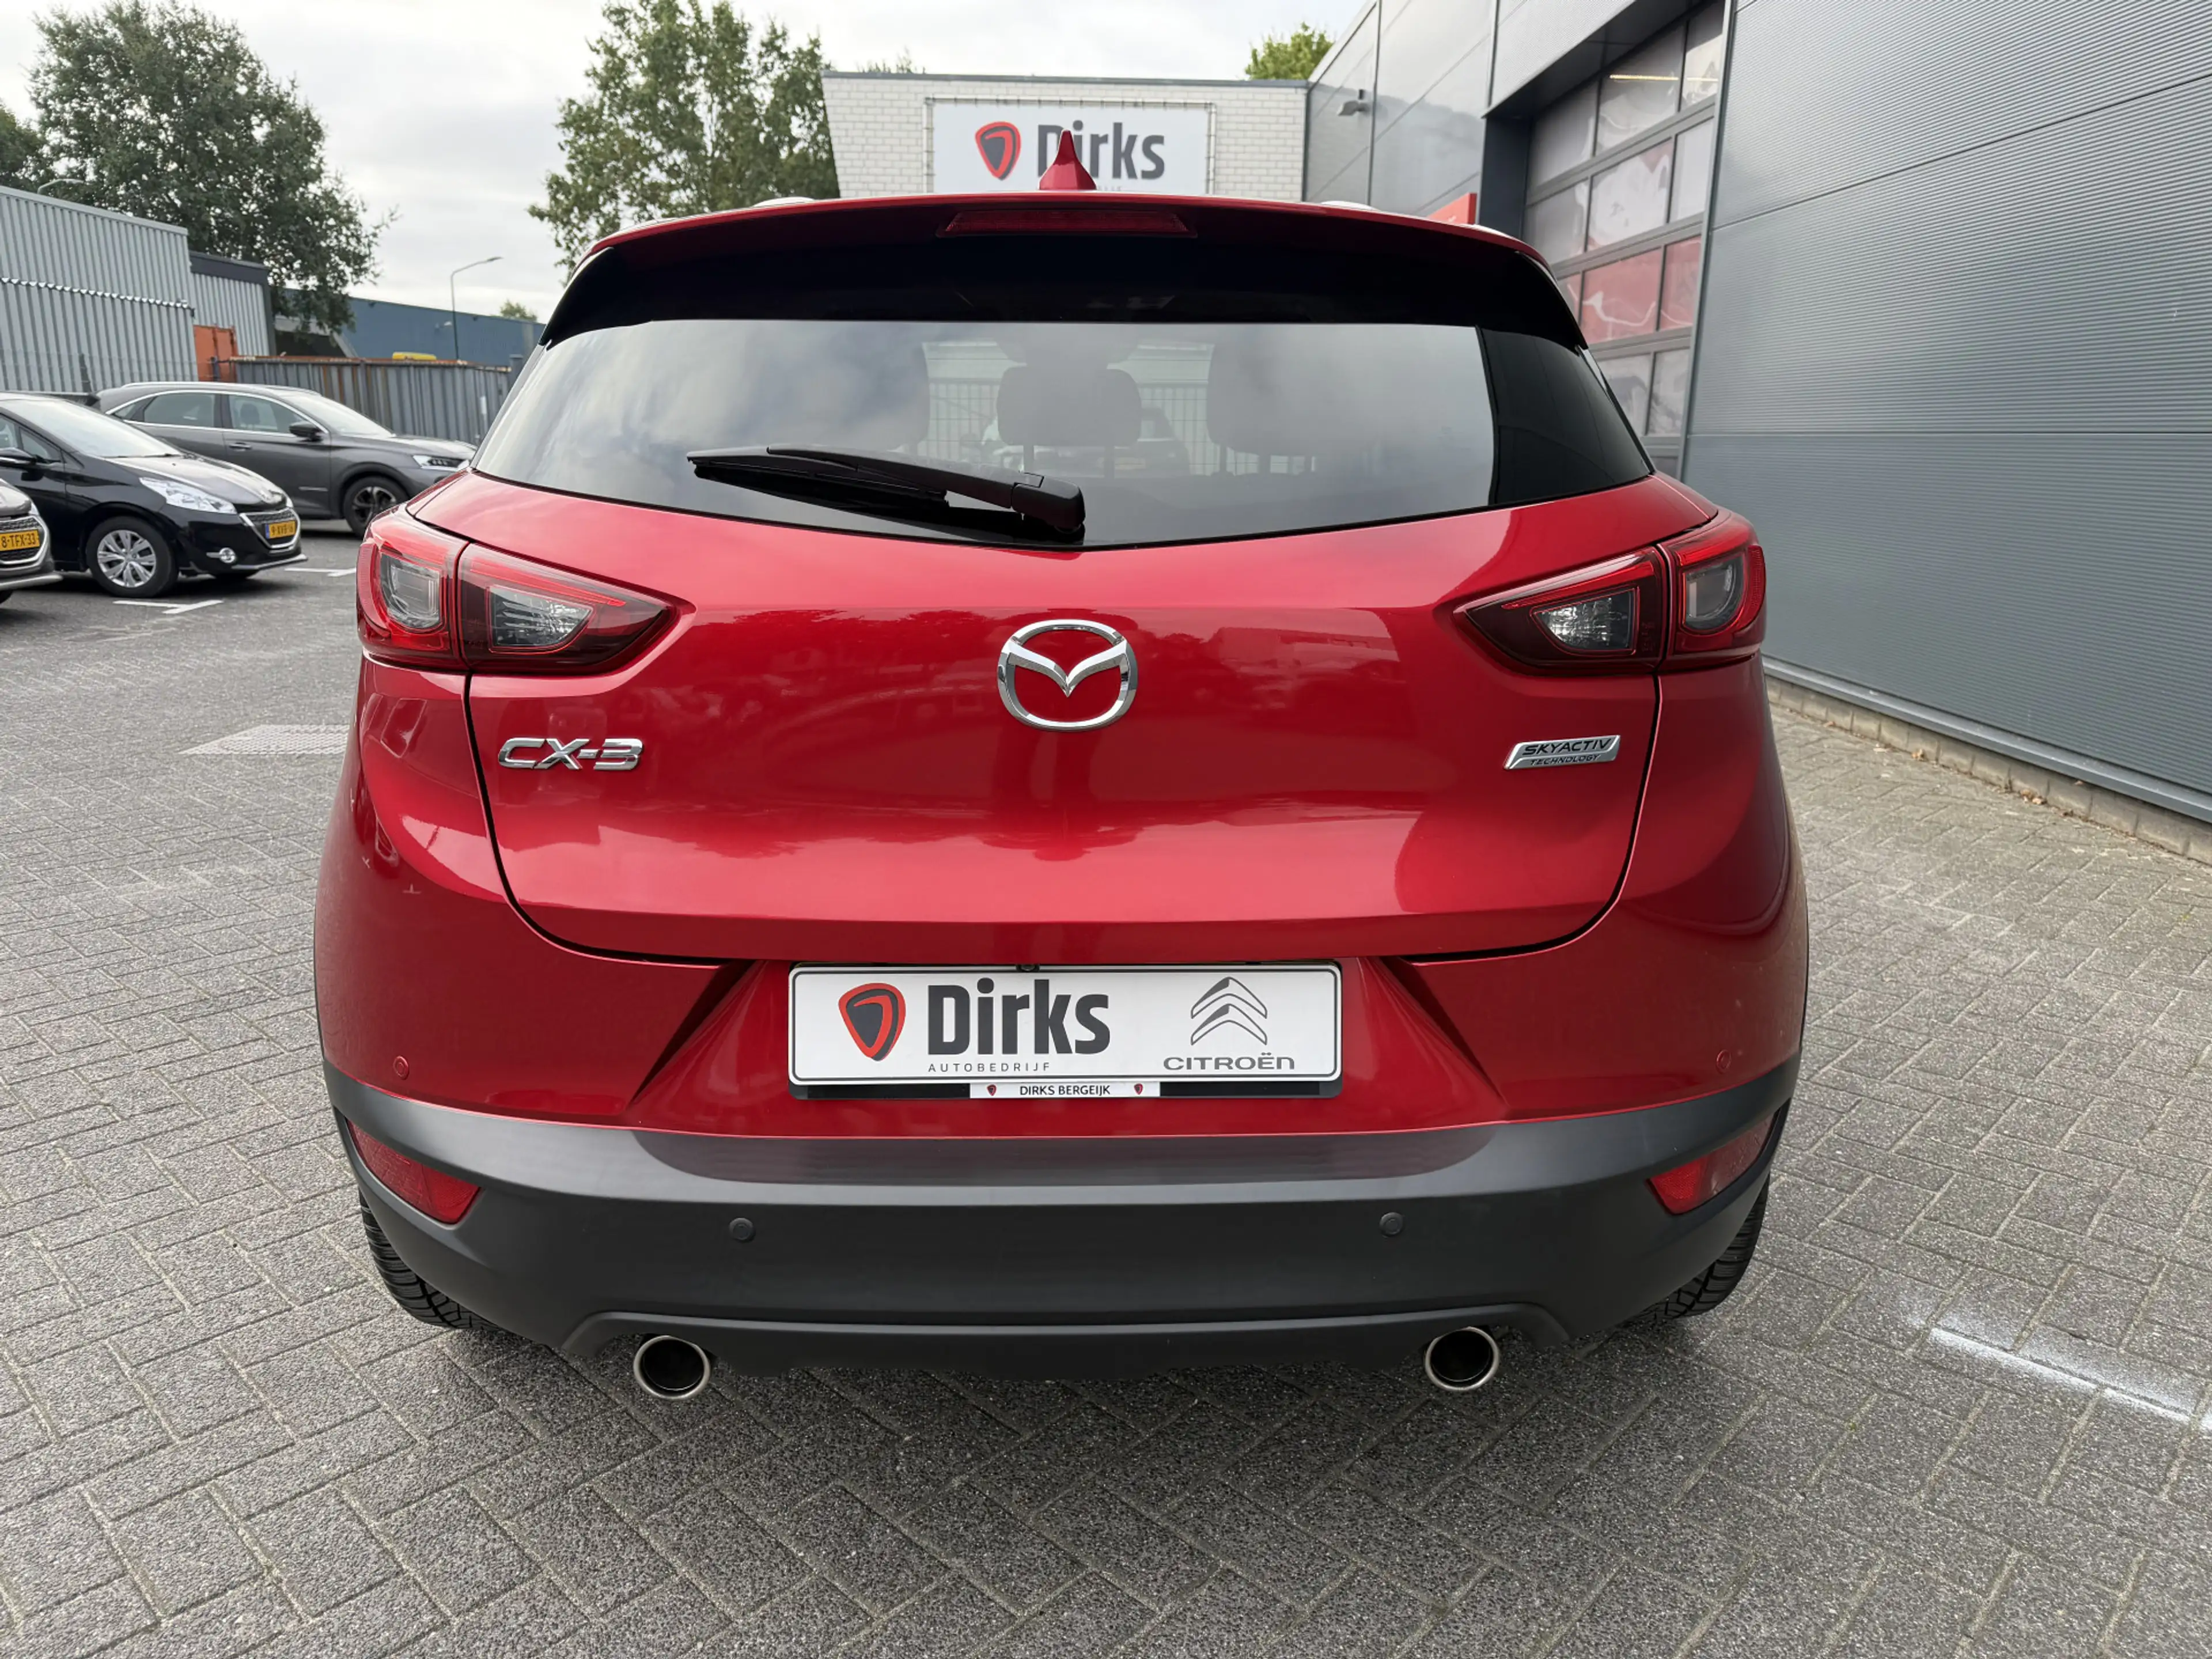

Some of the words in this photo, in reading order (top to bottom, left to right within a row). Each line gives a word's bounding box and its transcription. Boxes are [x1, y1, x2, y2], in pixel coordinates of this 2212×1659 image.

[1037, 120, 1165, 180] Dirks
[2, 532, 36, 548] 8-TFX-33
[498, 737, 643, 770] CX-3
[1522, 738, 1611, 756] SKYACTIV
[1530, 753, 1601, 766] TECHNOLOGY
[928, 978, 1111, 1055] Dirks
[928, 1063, 1050, 1072] AUTOBEDRIJF
[1020, 1085, 1055, 1096] DIRKS
[1058, 1085, 1111, 1096] BERGEIJK
